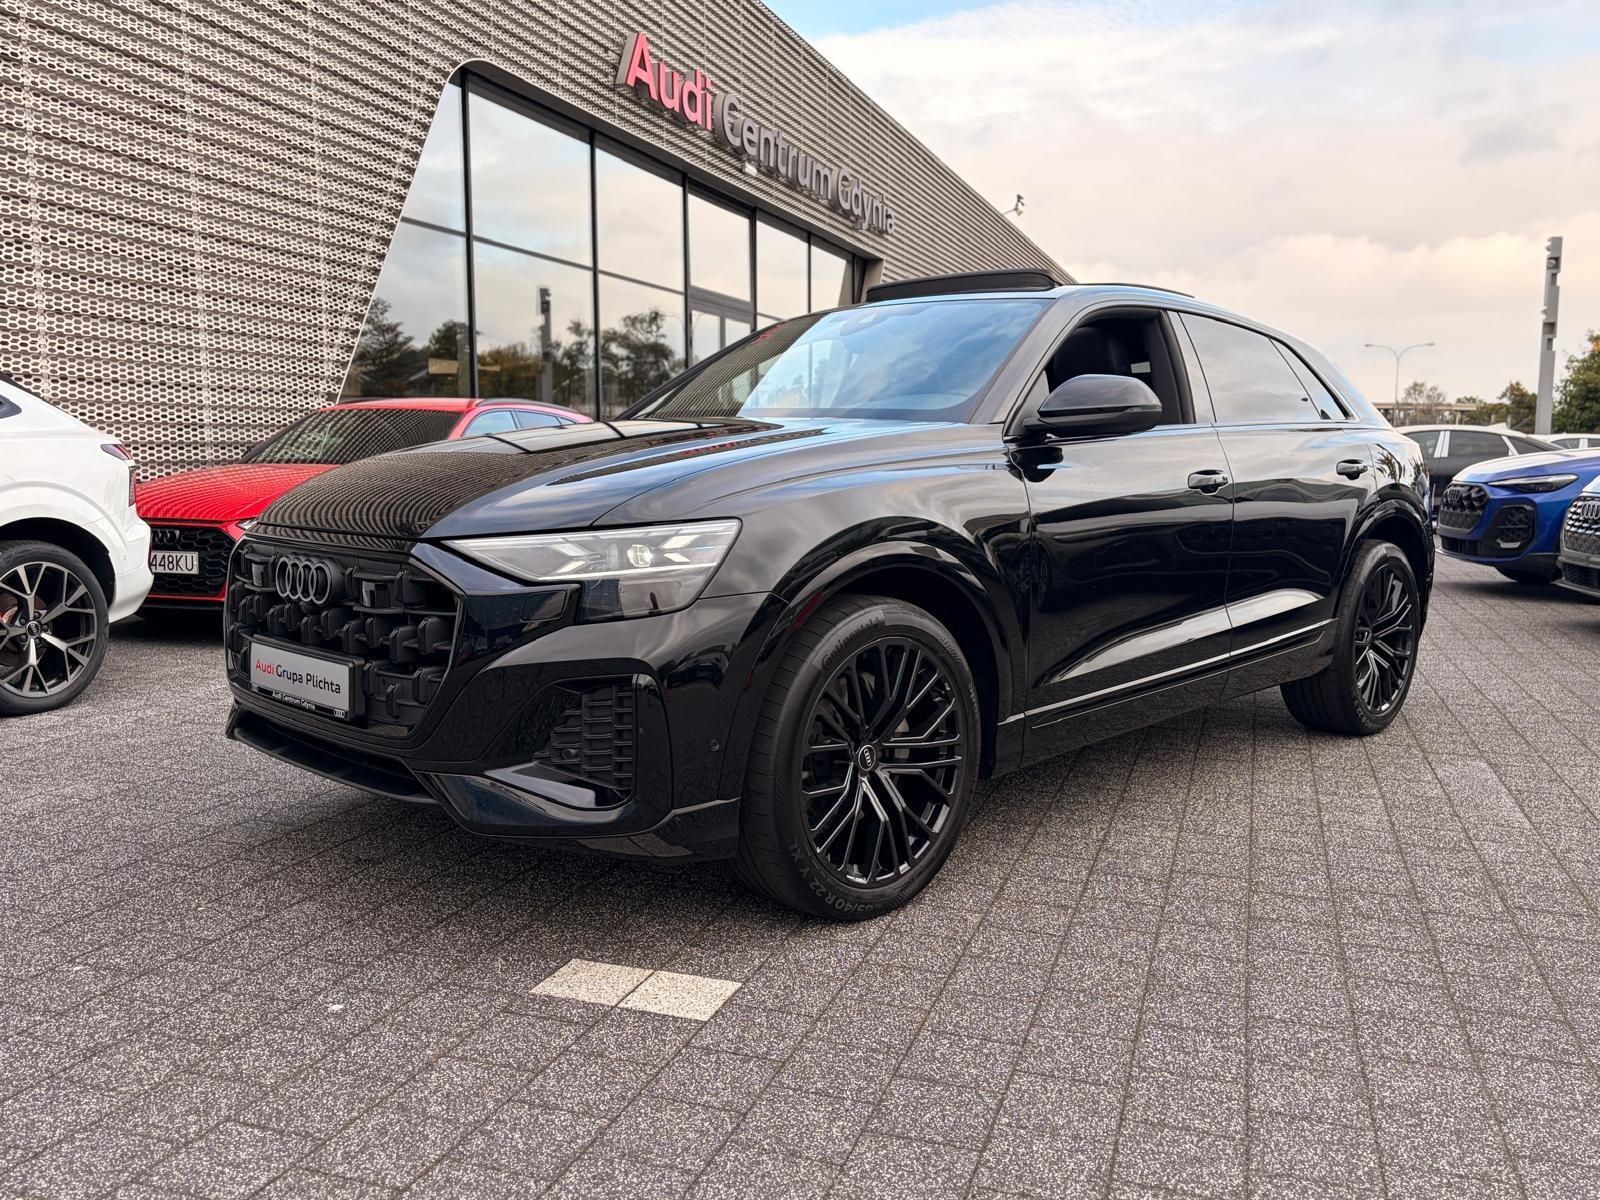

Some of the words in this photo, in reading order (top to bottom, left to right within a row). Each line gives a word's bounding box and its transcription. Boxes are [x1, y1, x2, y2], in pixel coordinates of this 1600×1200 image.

[617, 31, 712, 131] Audi
[715, 93, 832, 199] Centrum
[832, 167, 896, 234] Gdynia
[150, 553, 194, 572] 448KU
[255, 658, 275, 676] Audi
[275, 664, 303, 685] Grupa
[305, 672, 341, 694] Plichta
[282, 693, 300, 705] Centrum
[300, 699, 315, 711] Gdynia
